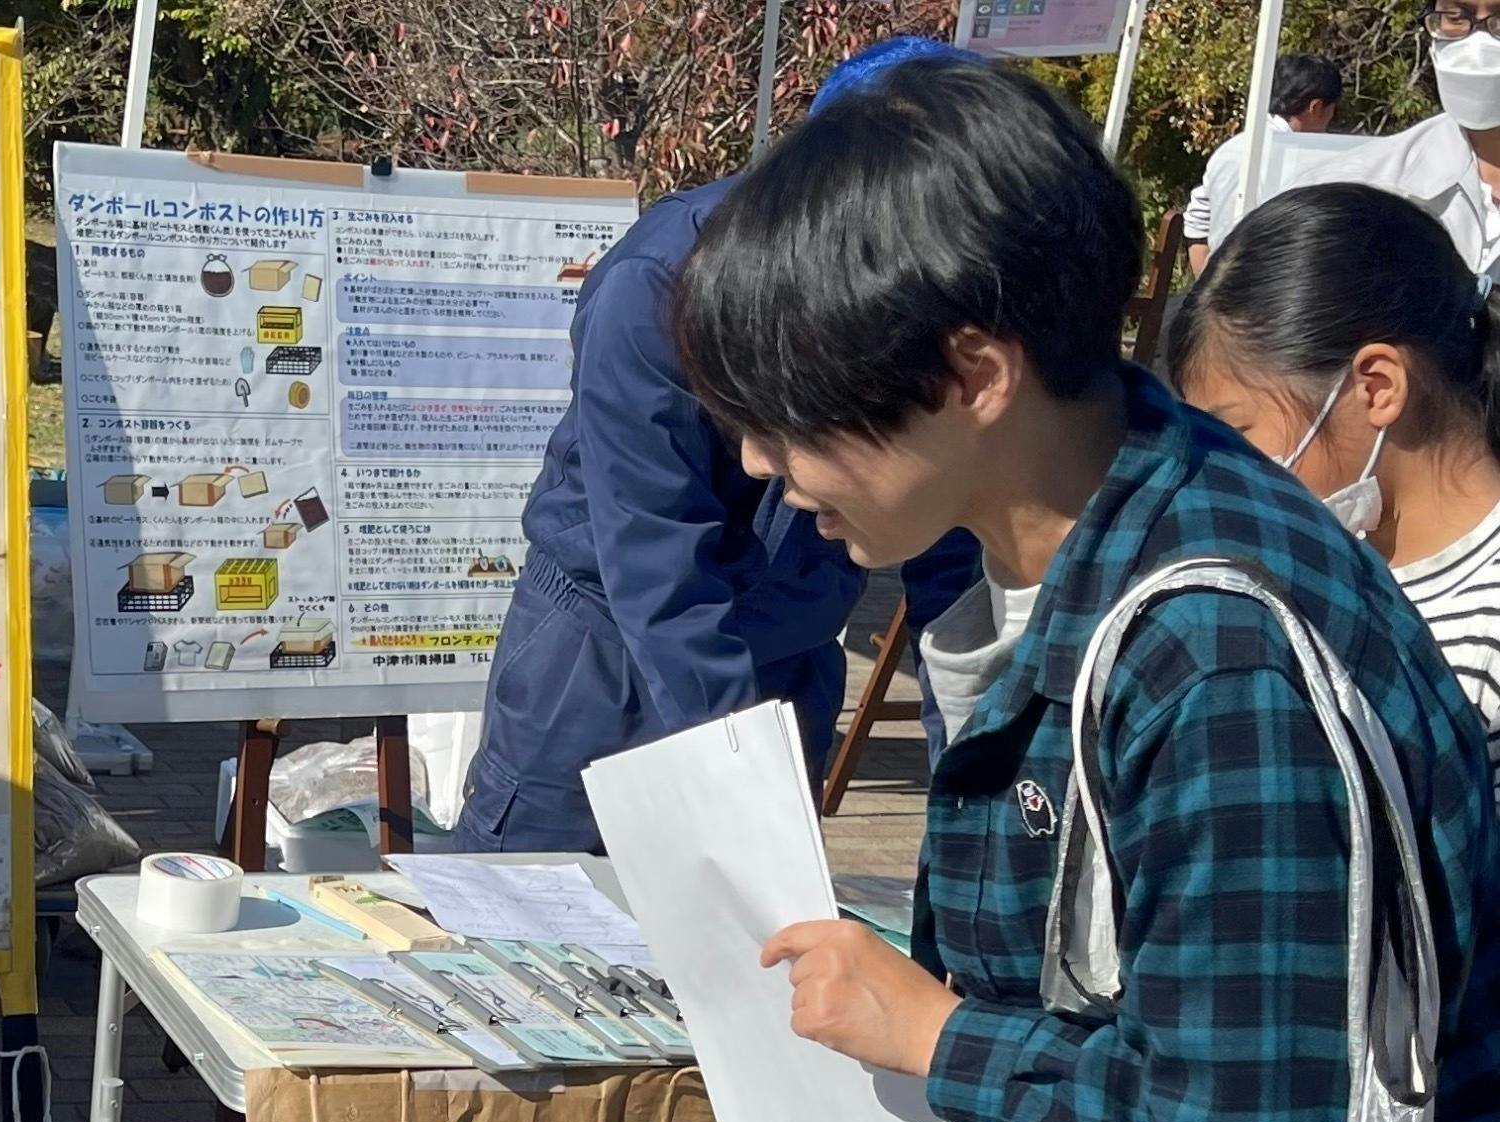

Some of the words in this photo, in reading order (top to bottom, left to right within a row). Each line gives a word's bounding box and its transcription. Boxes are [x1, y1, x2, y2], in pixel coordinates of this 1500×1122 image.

[67, 193, 326, 228] ダンボールコンポストの作り方
[99, 419, 192, 431] コンポスト容器をつくる
[470, 652, 491, 663] TEL
